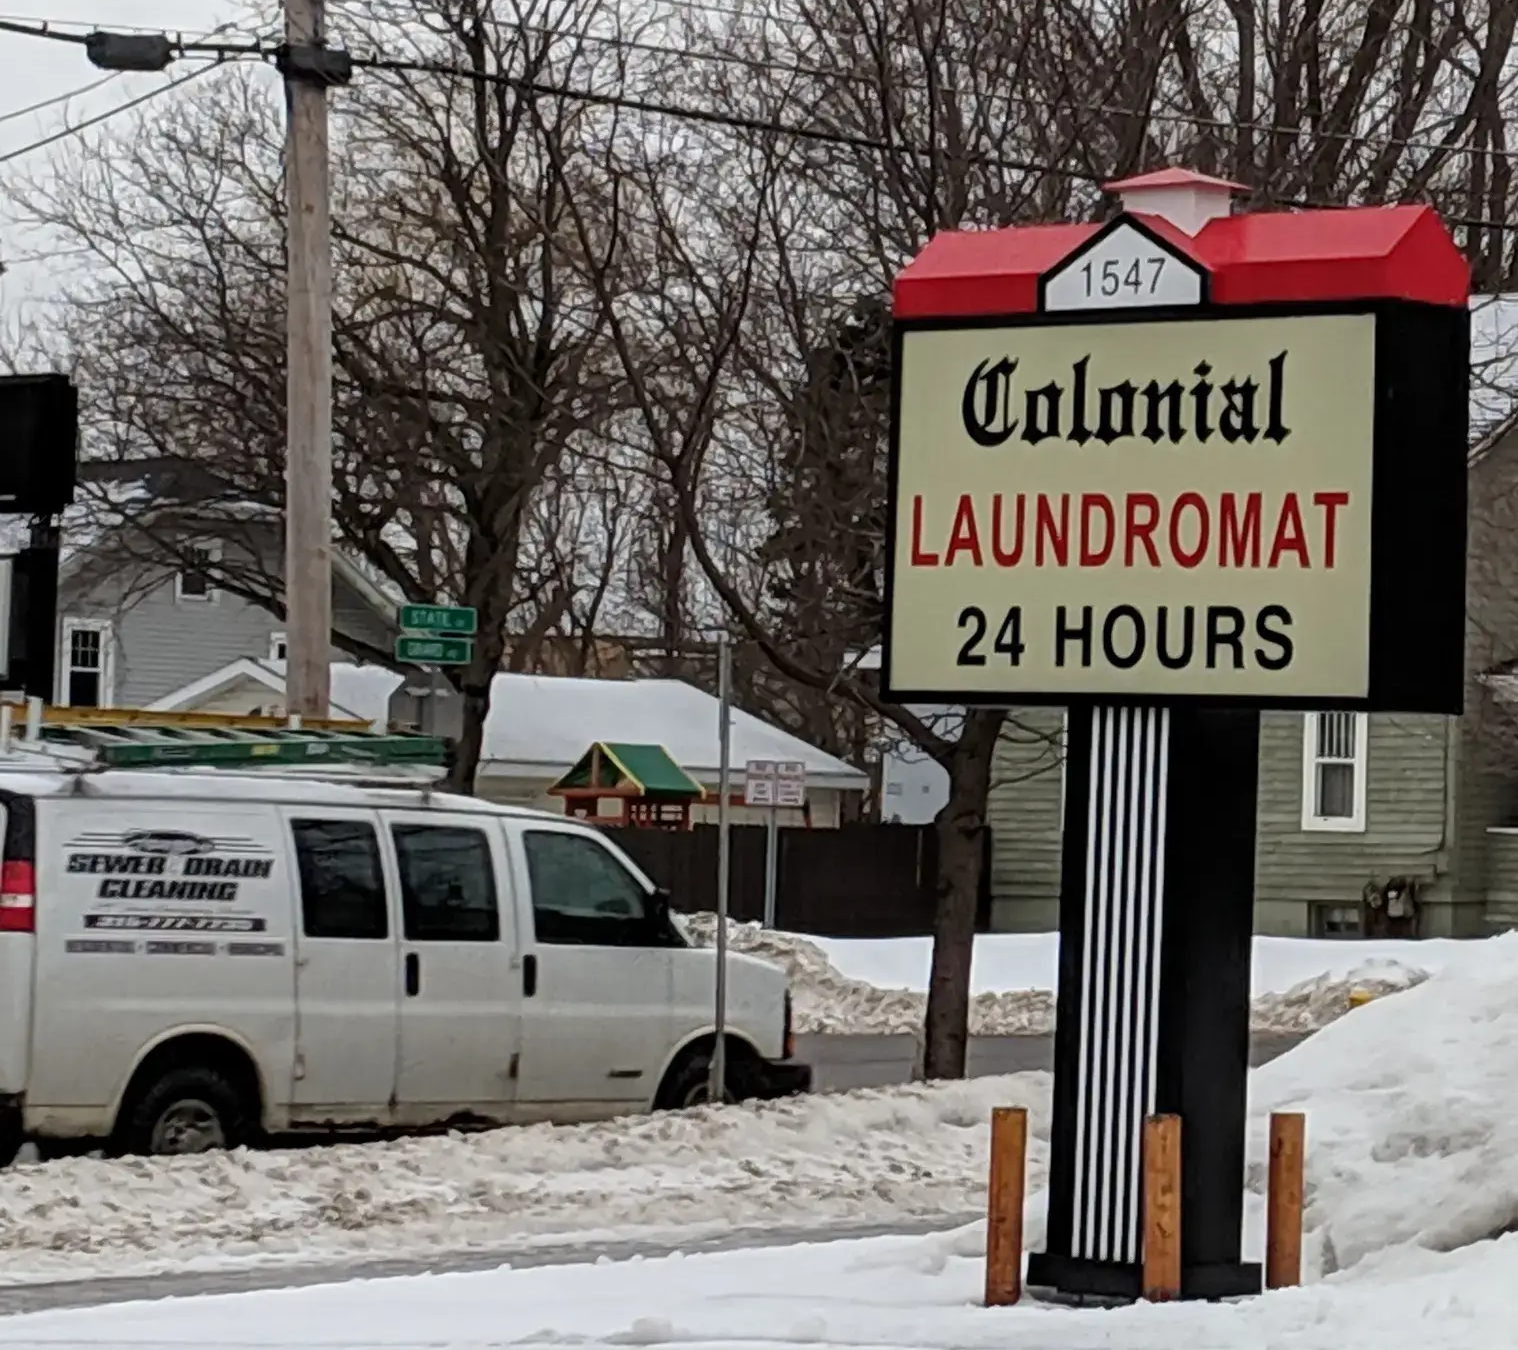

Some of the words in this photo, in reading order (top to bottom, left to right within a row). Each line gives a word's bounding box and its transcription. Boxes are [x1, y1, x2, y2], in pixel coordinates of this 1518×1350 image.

[1081, 259, 1166, 297] 1547
[963, 350, 1291, 447] Colonial
[911, 492, 1350, 568] LAUNDROMAT
[411, 610, 452, 627] STATE
[957, 606, 1025, 667] 24
[1055, 604, 1294, 669] HOURS
[66, 853, 168, 875] SEWER
[182, 856, 275, 879] DRAIN
[98, 879, 239, 900] CLEANING
